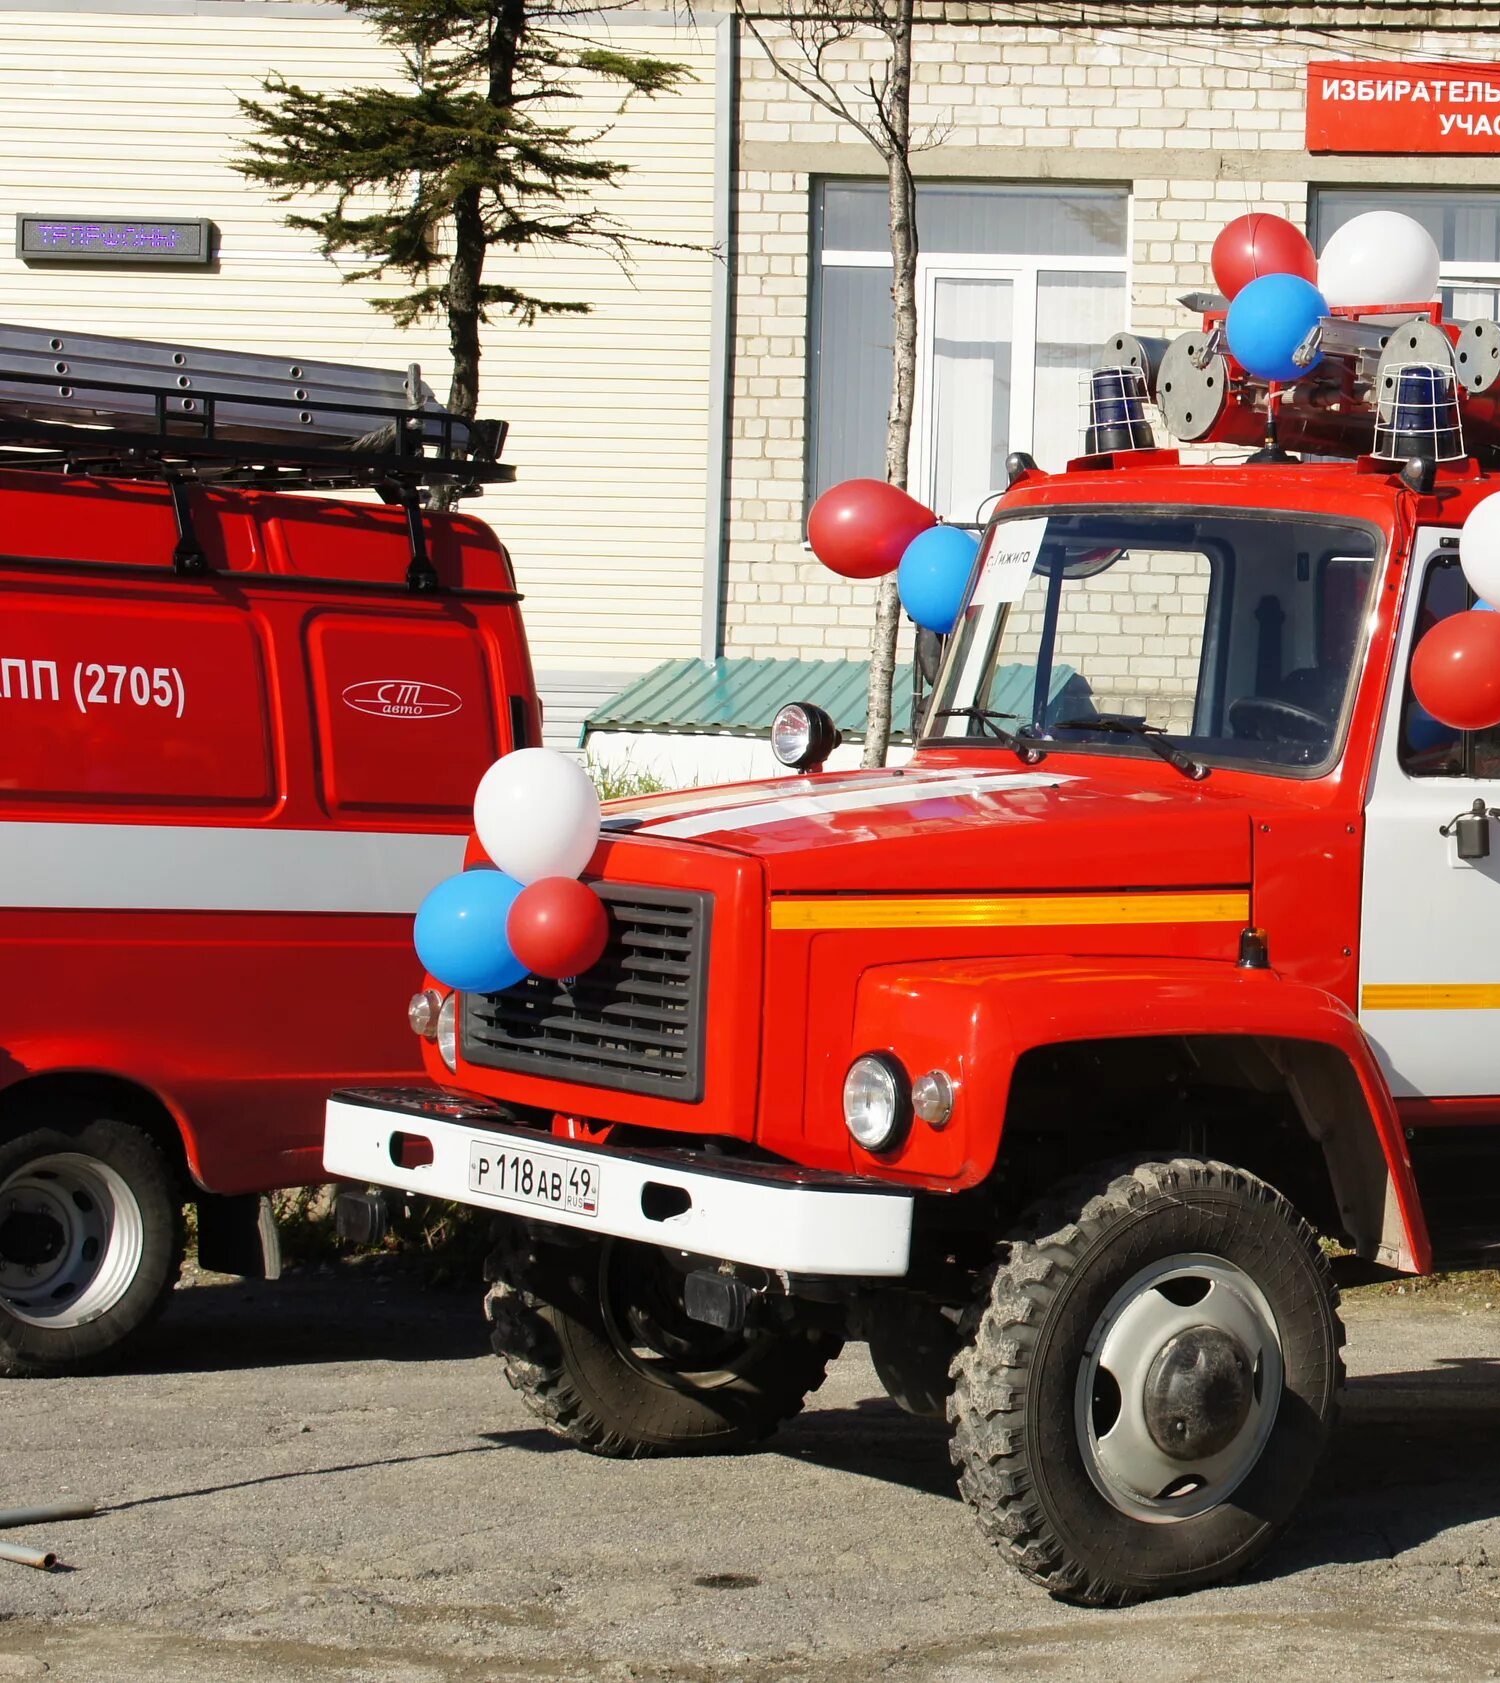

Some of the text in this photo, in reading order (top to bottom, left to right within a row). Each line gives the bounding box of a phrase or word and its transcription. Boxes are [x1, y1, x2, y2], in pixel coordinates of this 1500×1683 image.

[0, 657, 185, 718] ПП (2705)
[382, 704, 423, 715] авто
[567, 1195, 583, 1208] RUS
